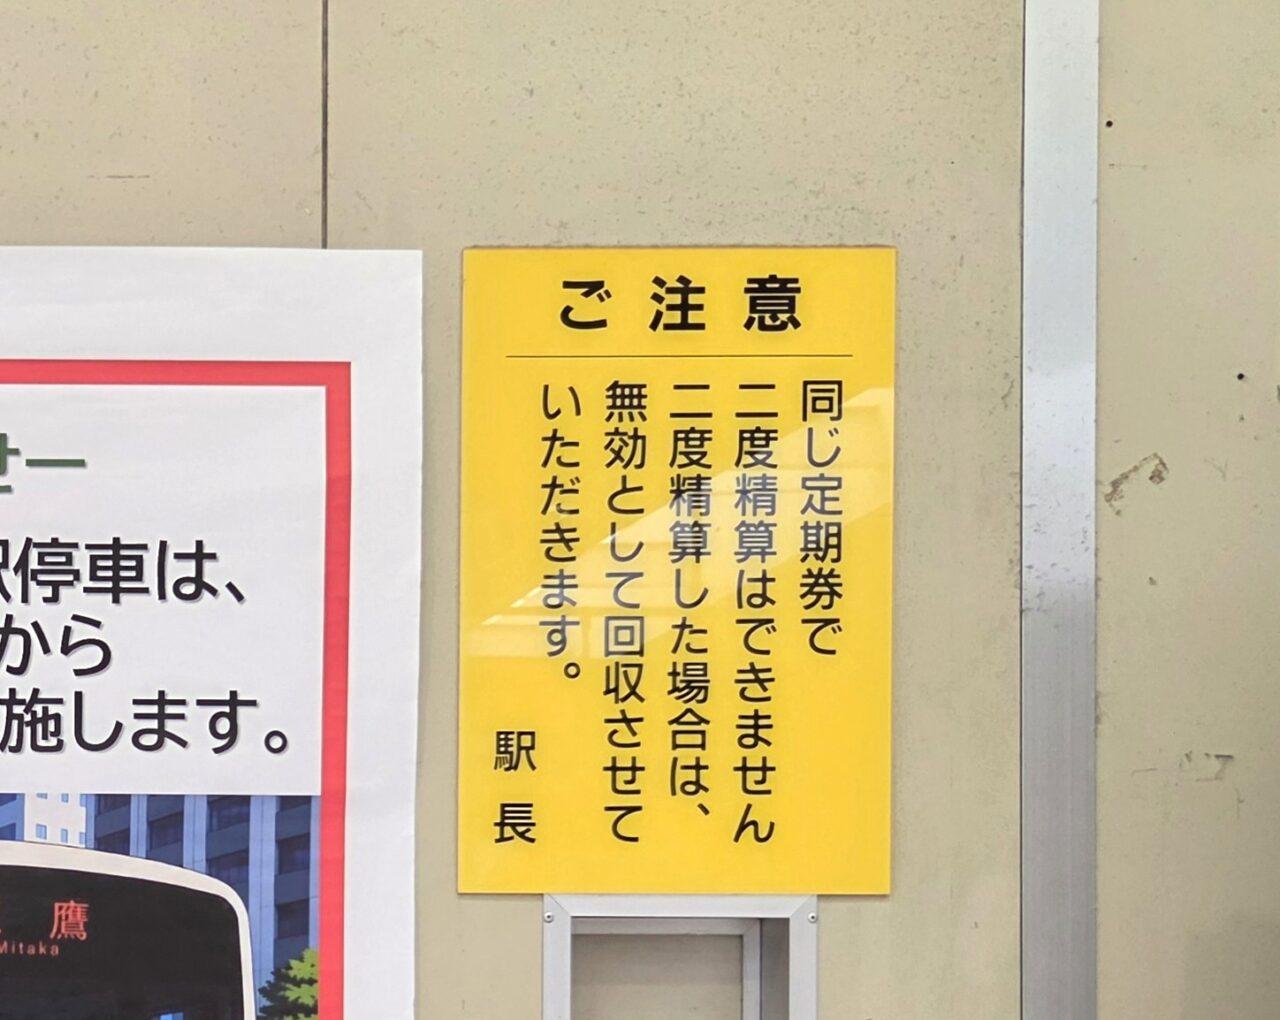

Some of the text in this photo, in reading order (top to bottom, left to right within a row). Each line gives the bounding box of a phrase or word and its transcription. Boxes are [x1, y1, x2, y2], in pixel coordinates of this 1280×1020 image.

[560, 274, 802, 332] ご注意
[538, 383, 582, 680] いただきます。
[602, 379, 649, 843] 無効として回収させて
[666, 383, 714, 816] 二度精算した場合は、
[732, 383, 779, 844] 二度精算はできません
[799, 379, 844, 656] 同じ定期券で
[493, 730, 537, 844] 駅長
